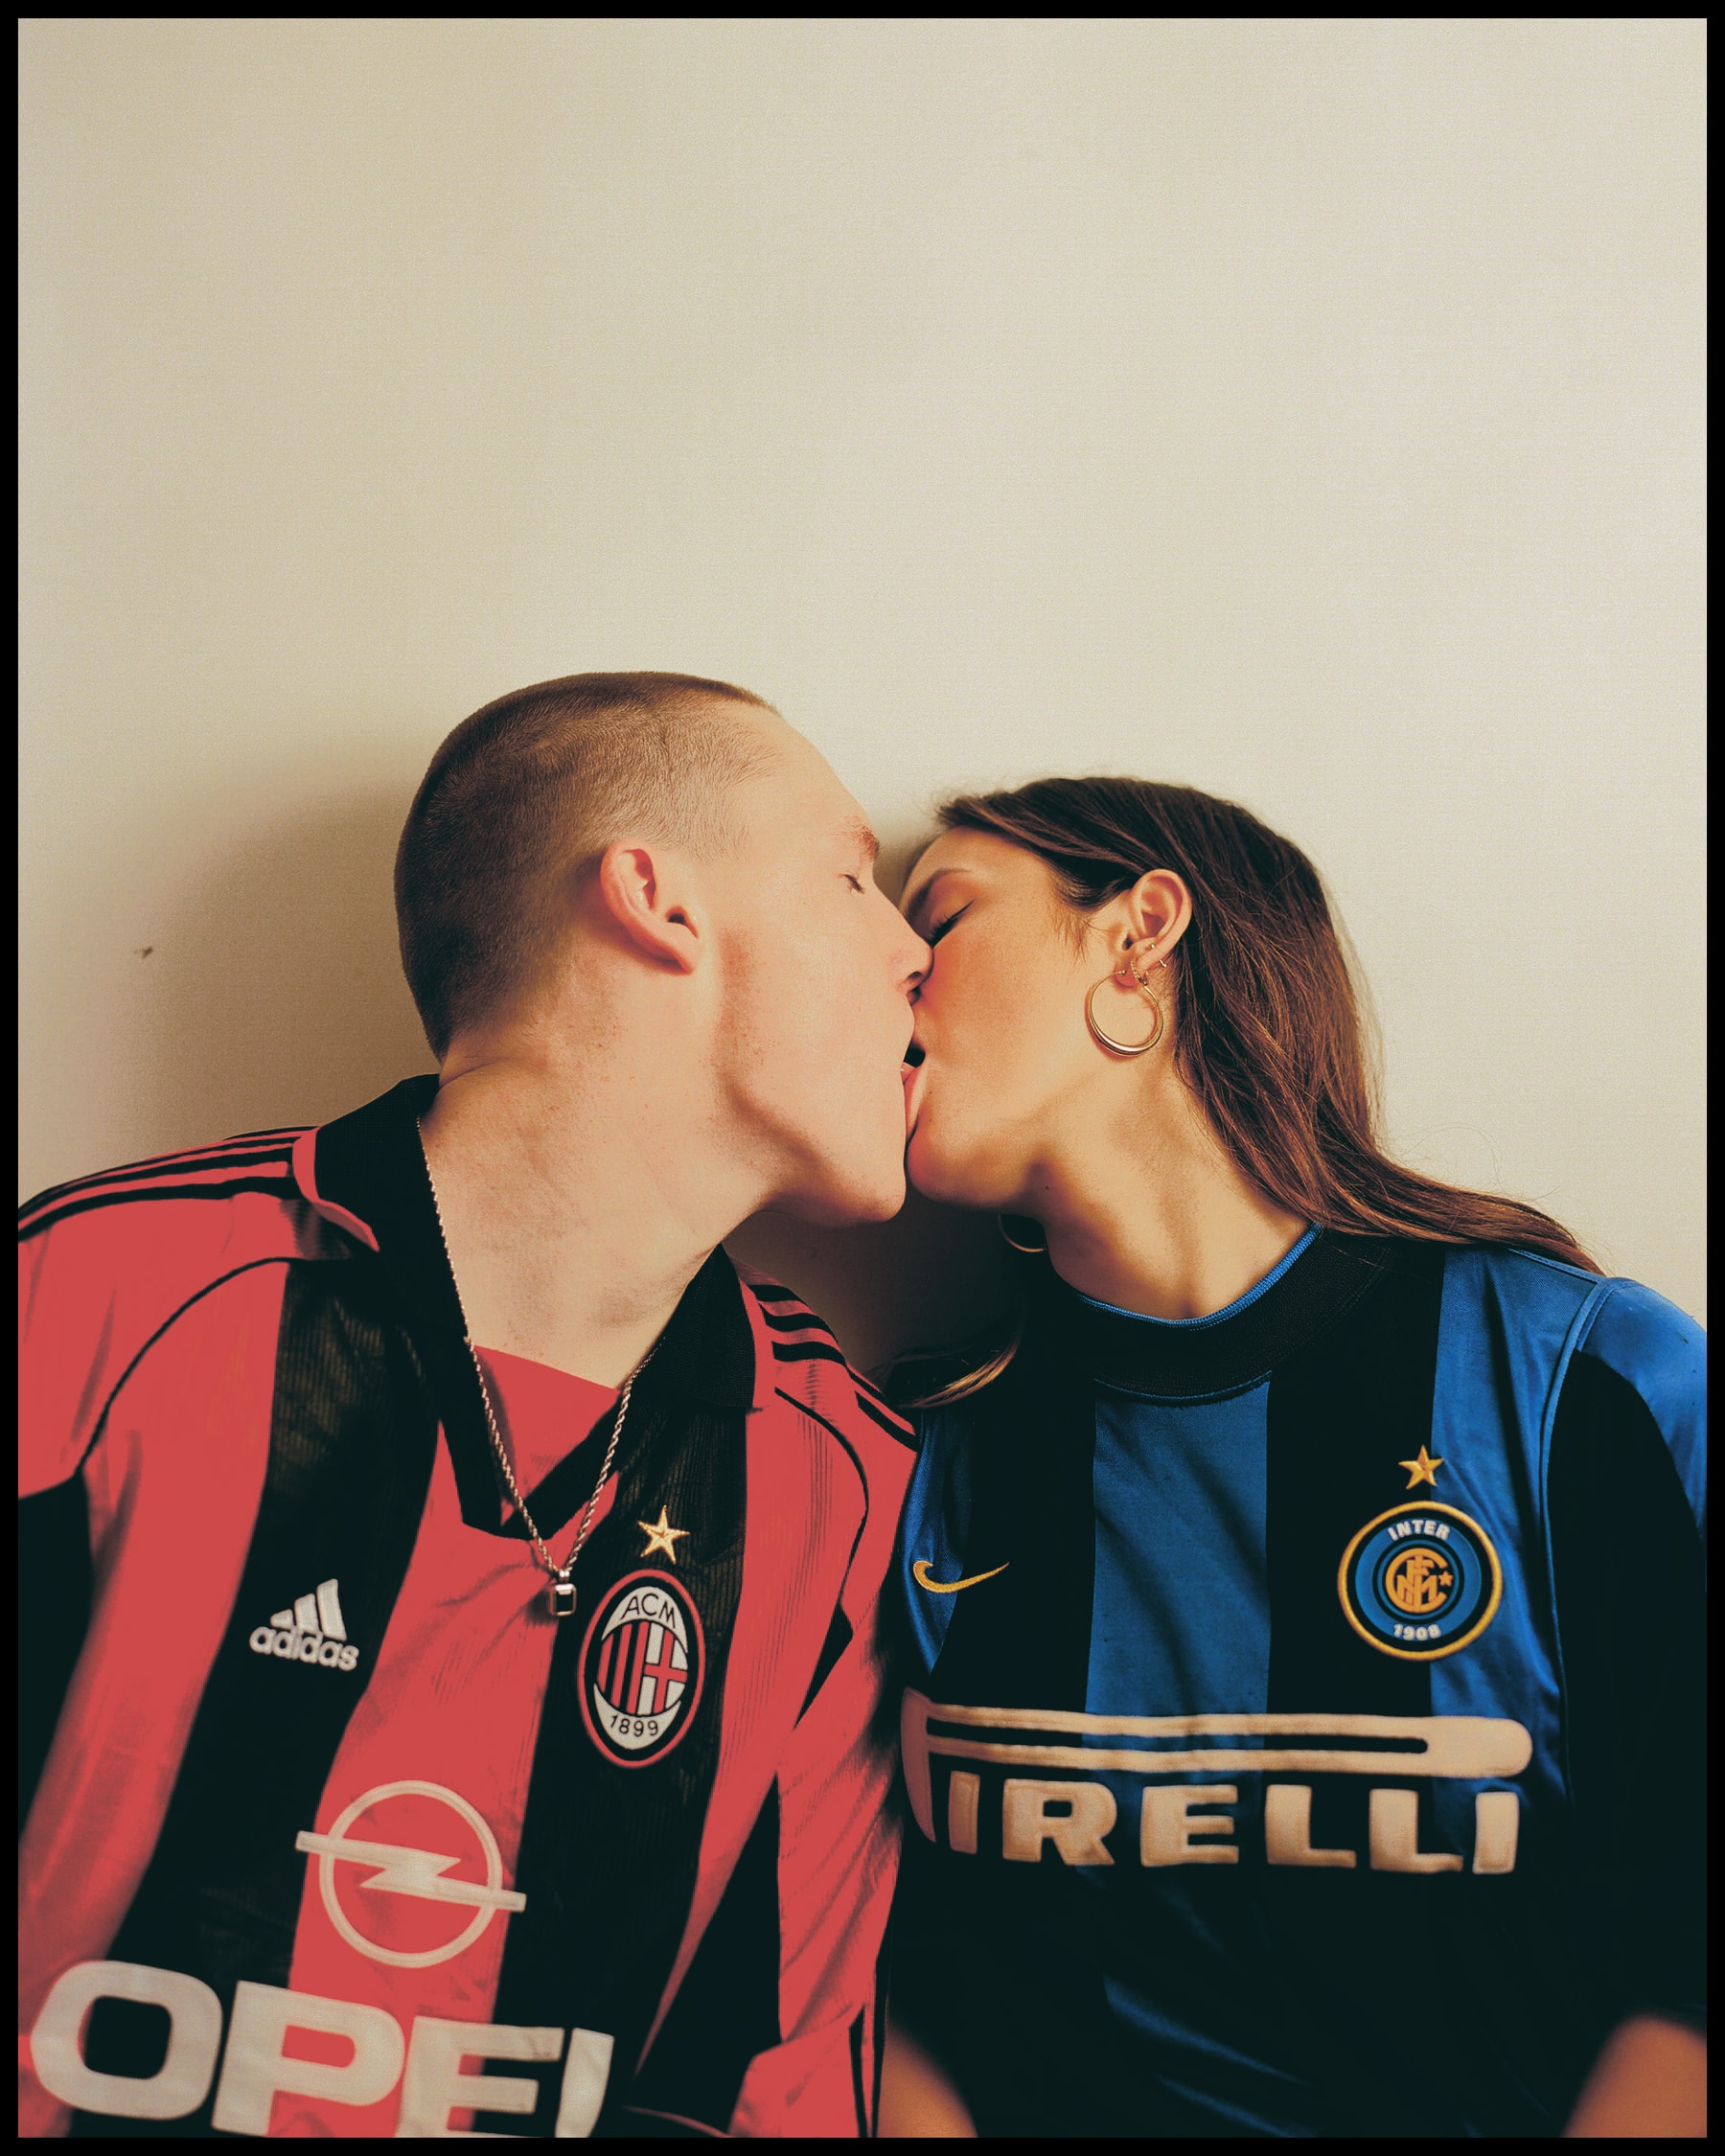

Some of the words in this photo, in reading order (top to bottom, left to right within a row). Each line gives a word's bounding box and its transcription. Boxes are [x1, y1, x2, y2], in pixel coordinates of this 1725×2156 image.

[1388, 1519, 1451, 1541] INTER
[621, 1593, 676, 1629] ACM
[1393, 1623, 1441, 1641] 1908
[249, 1624, 359, 1671] adidas
[610, 1714, 658, 1737] 1899
[901, 1686, 1533, 1874] PIRELLI
